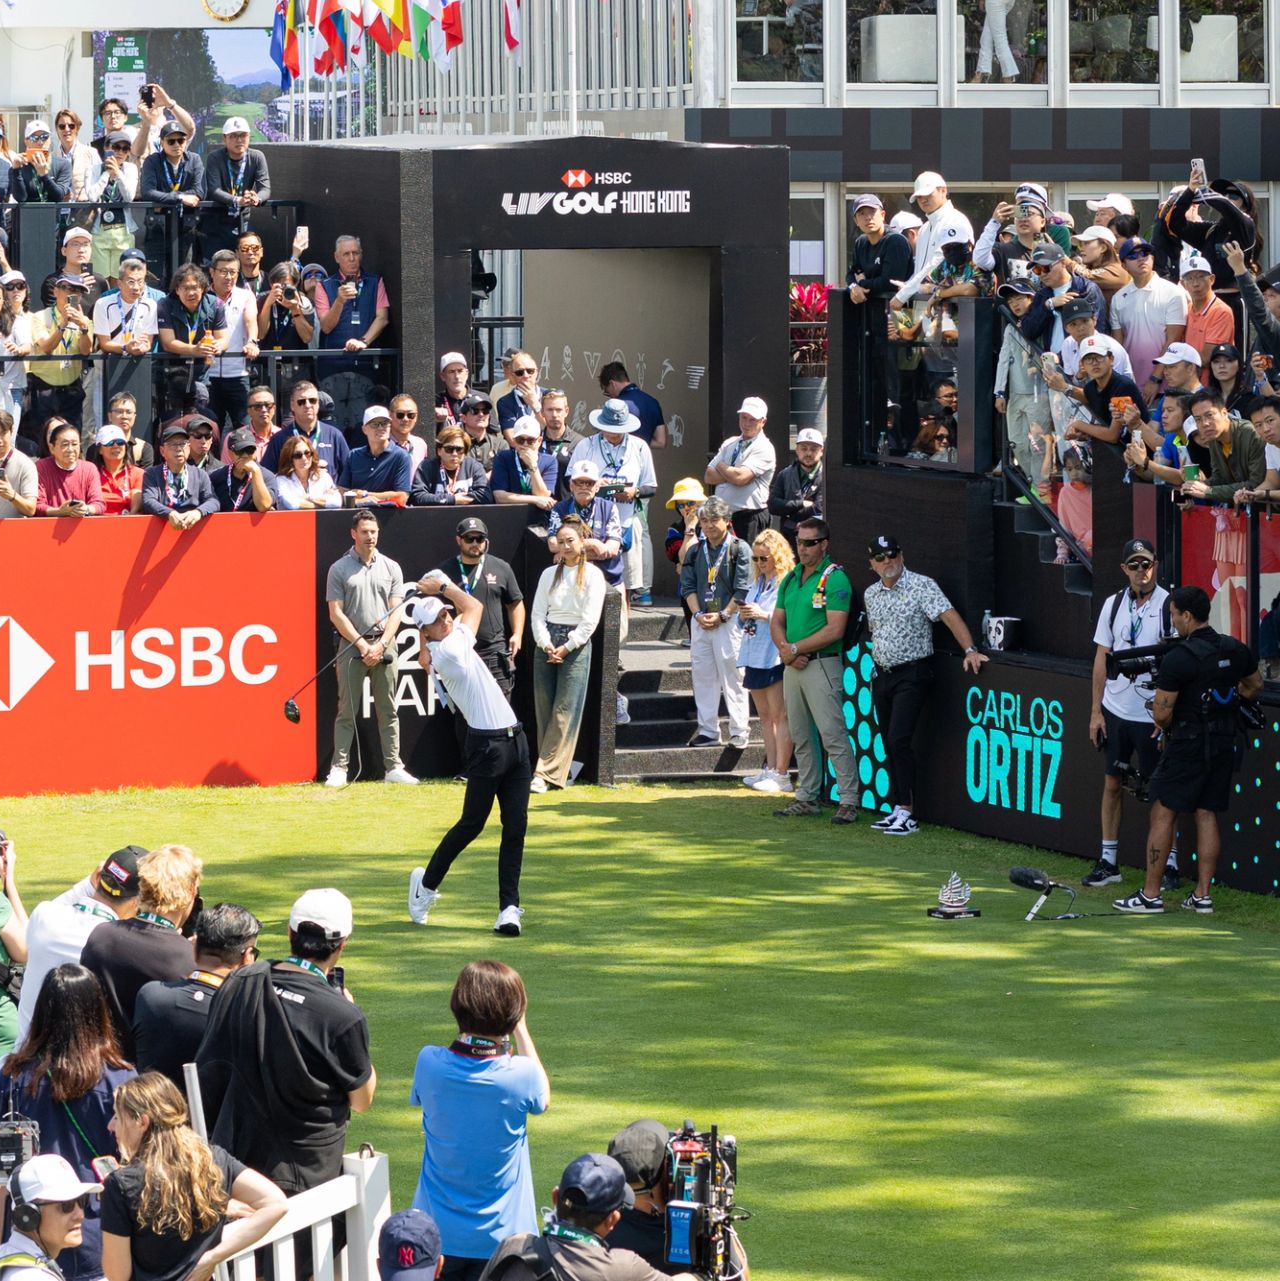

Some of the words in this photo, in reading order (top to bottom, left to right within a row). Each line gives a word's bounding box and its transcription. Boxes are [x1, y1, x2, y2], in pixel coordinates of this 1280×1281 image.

[594, 172, 632, 185] HSBC
[501, 191, 555, 216] LIV
[552, 191, 618, 215] GOLF
[619, 191, 656, 214] HONG
[656, 190, 691, 213] KONG
[74, 623, 279, 691] HSBC
[965, 685, 1064, 740] CARLOS
[965, 724, 1063, 820] ORTIZ
[471, 1047, 497, 1056] Canon
